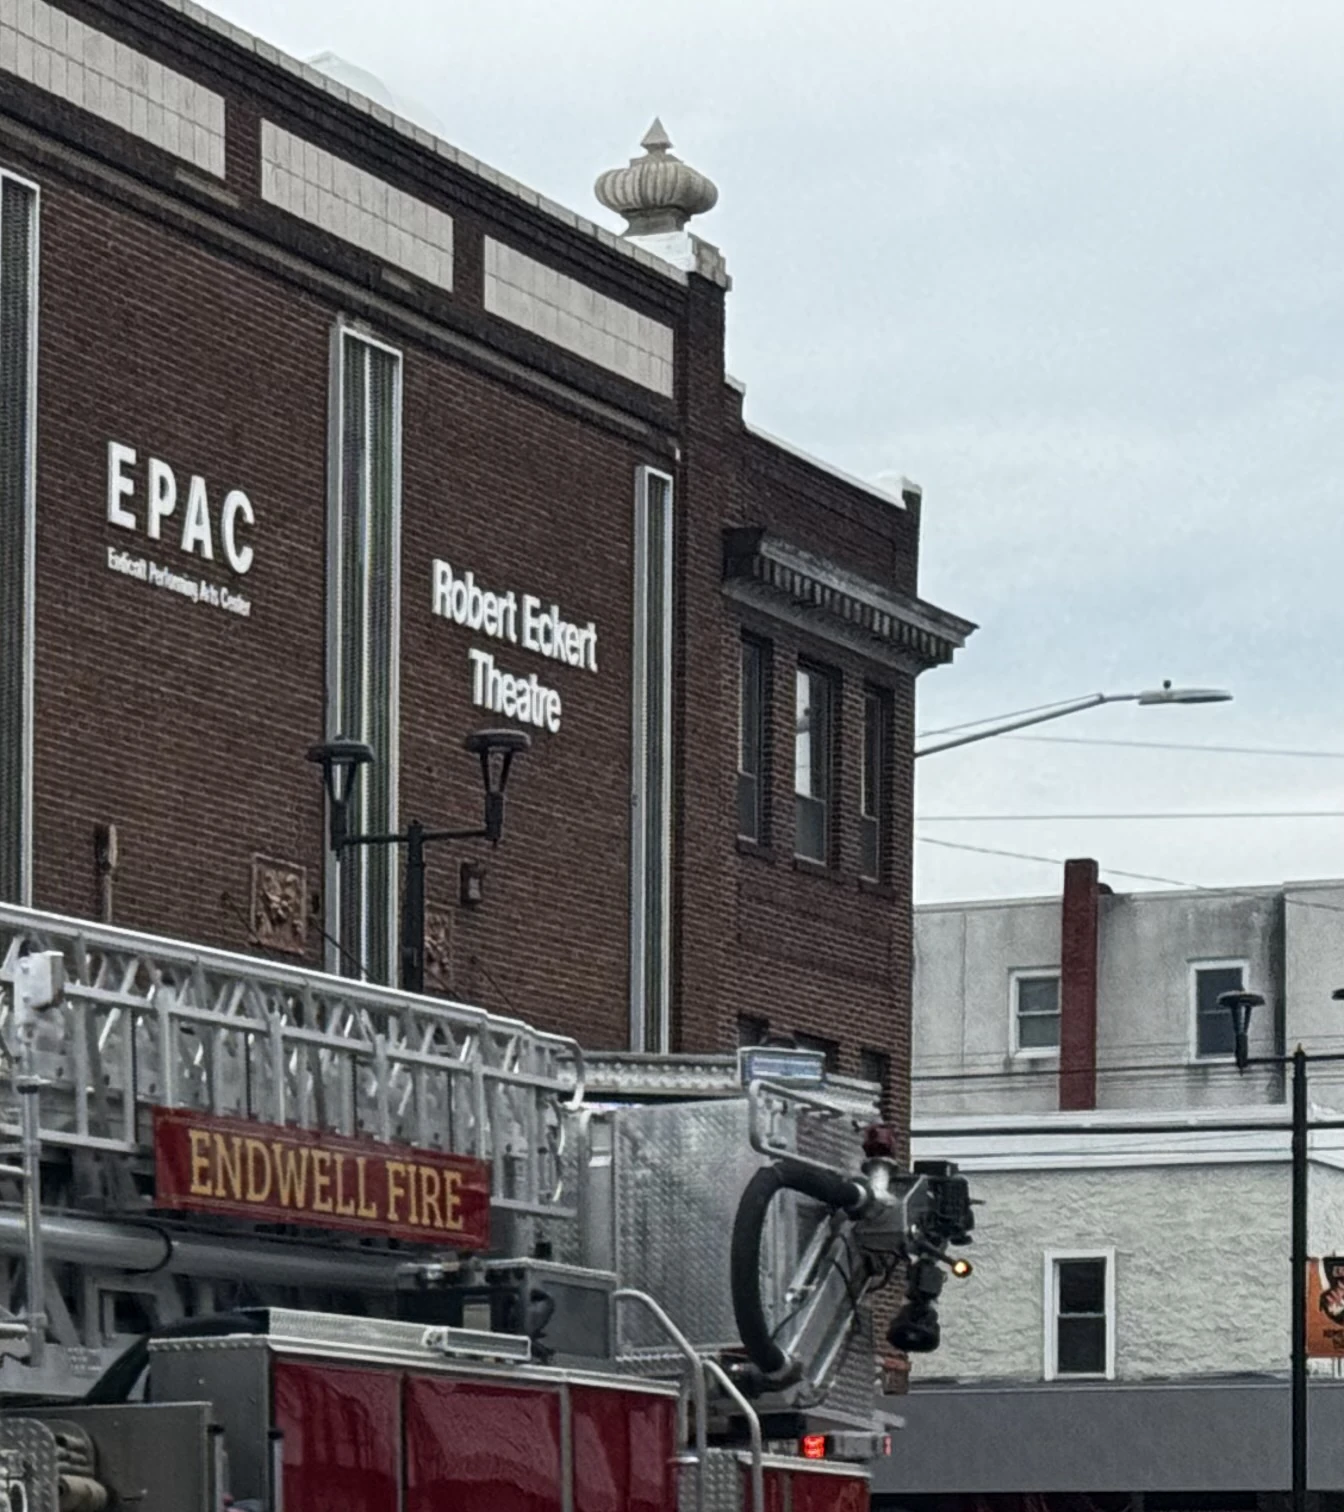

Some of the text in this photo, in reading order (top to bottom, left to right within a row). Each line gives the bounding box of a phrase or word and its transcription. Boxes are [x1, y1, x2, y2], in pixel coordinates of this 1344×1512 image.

[107, 440, 255, 574] EPAC
[431, 558, 598, 673] Robert Eckert
[468, 647, 562, 733] Theatre
[188, 1129, 463, 1230] ENDWELL FIRE
